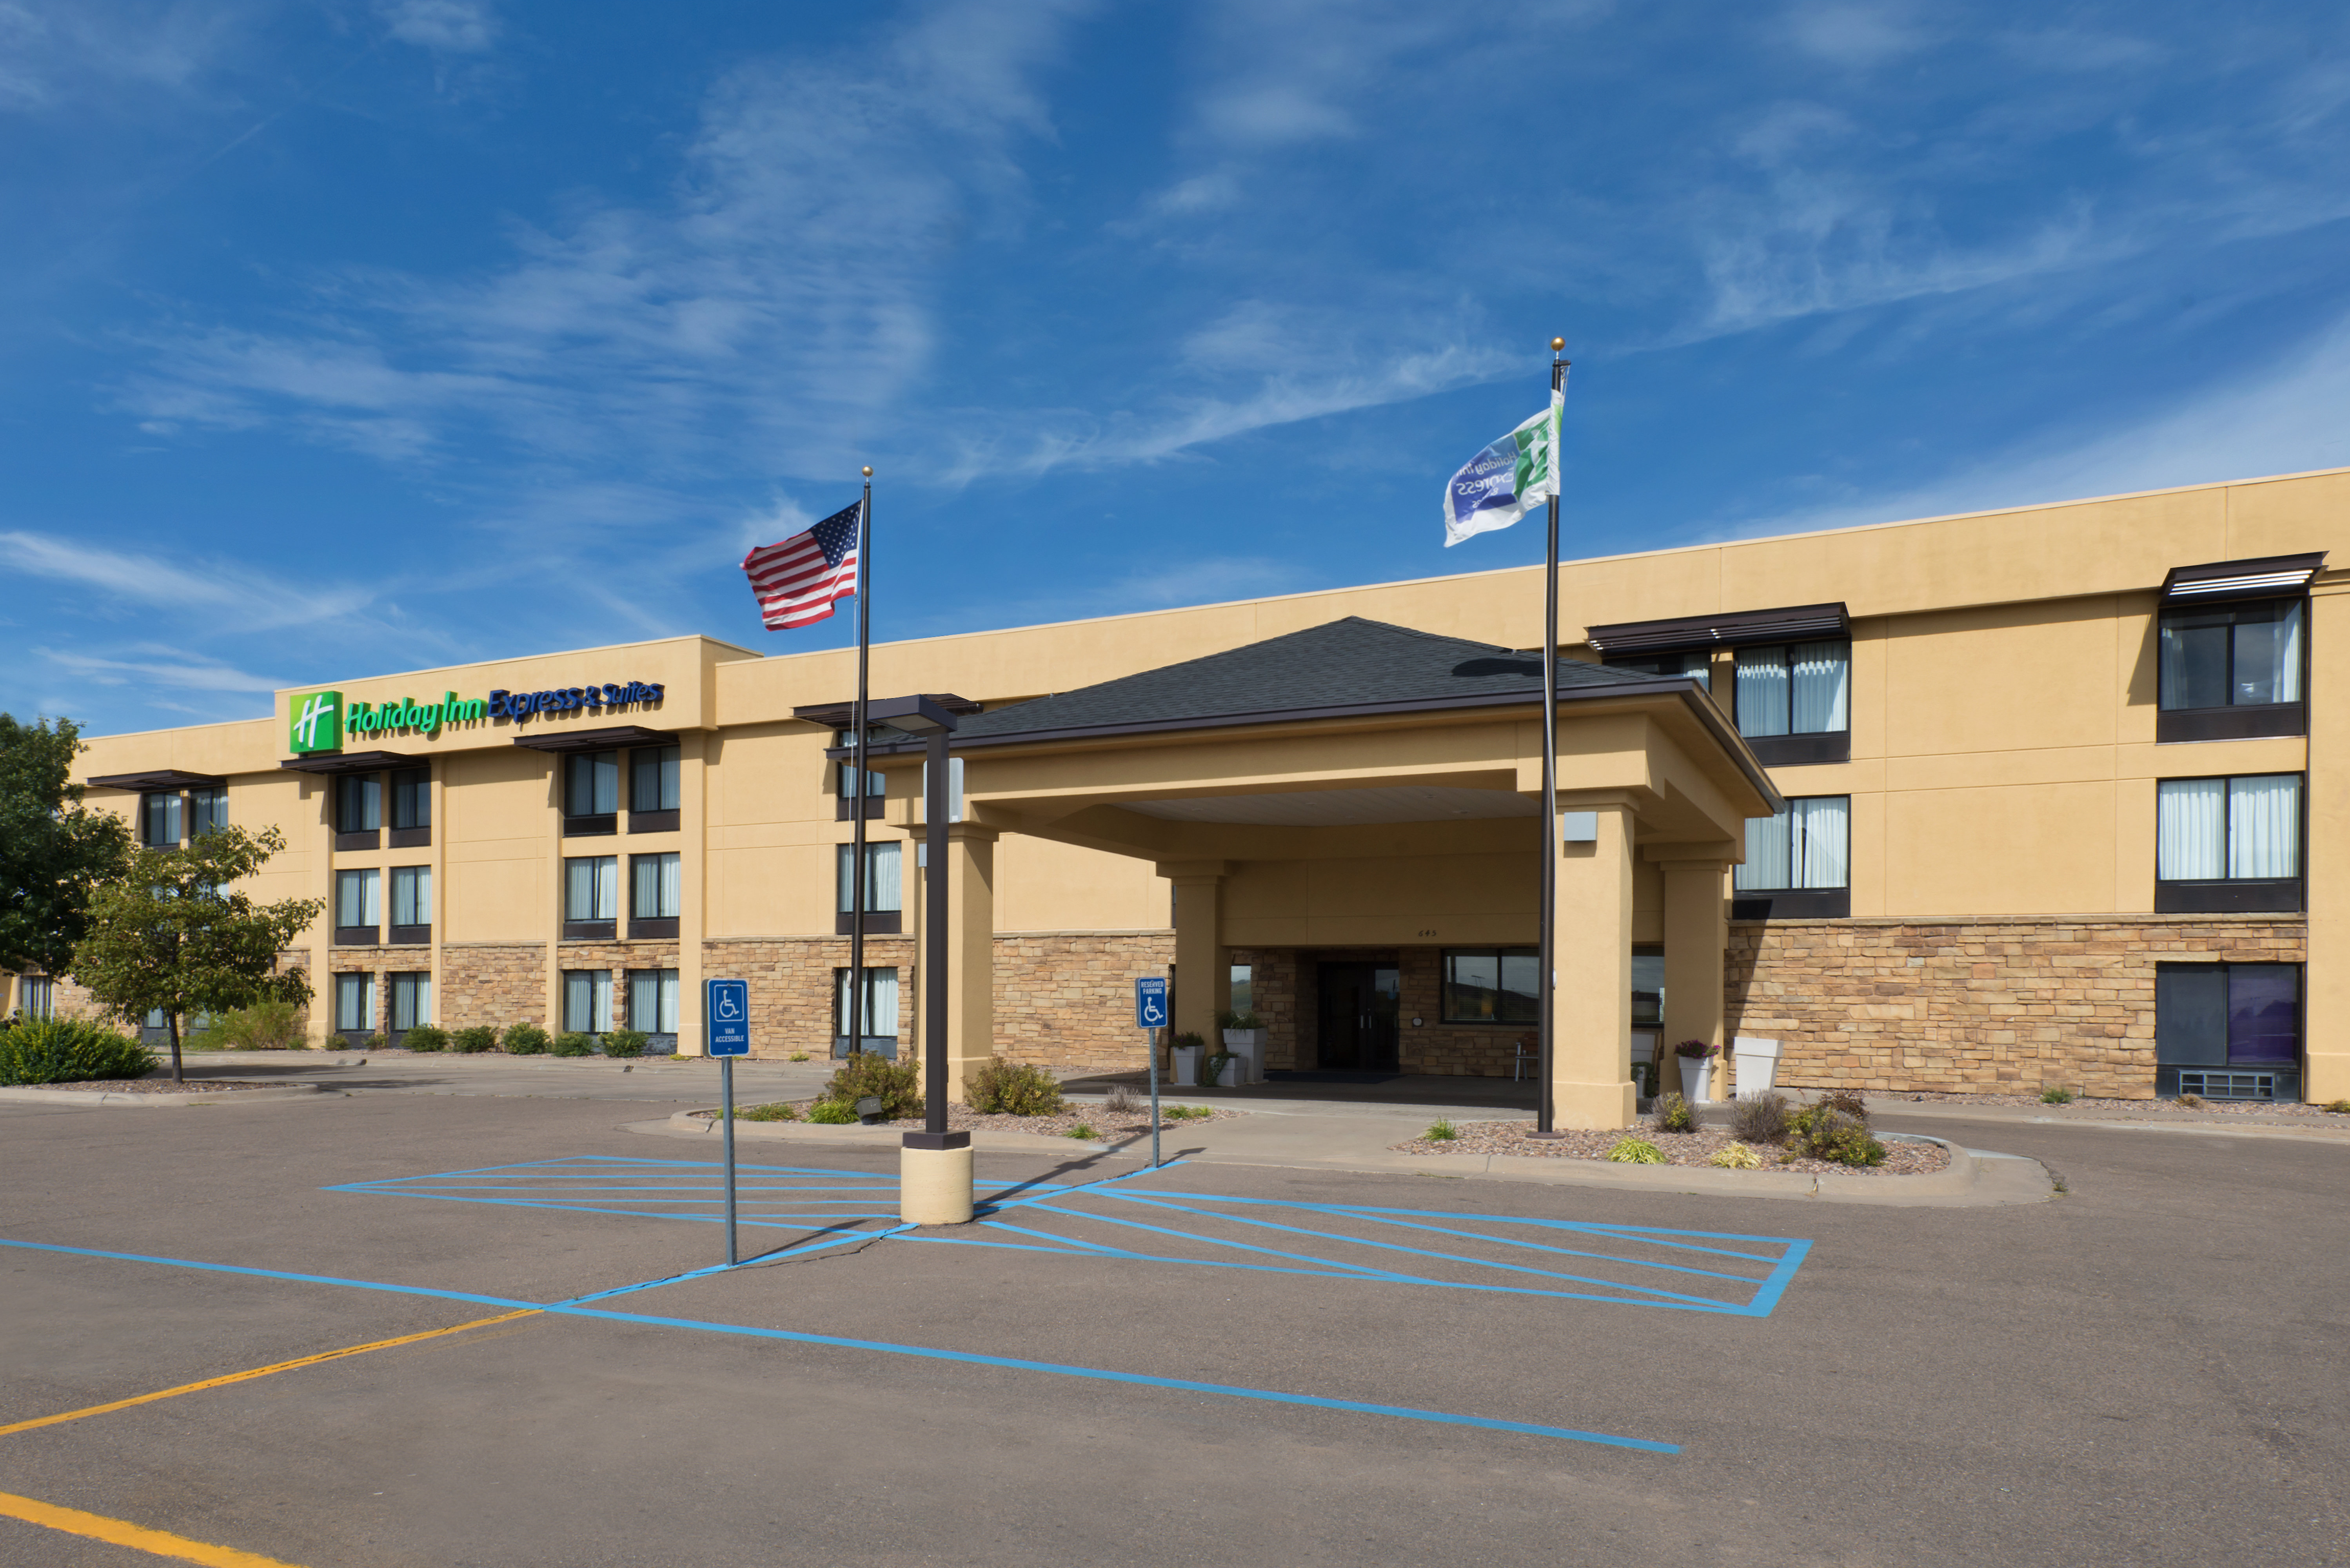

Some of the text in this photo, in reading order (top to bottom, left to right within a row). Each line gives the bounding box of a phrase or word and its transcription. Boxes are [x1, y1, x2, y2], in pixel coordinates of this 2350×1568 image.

[344, 681, 663, 733] Holiday Inn Express & Suites
